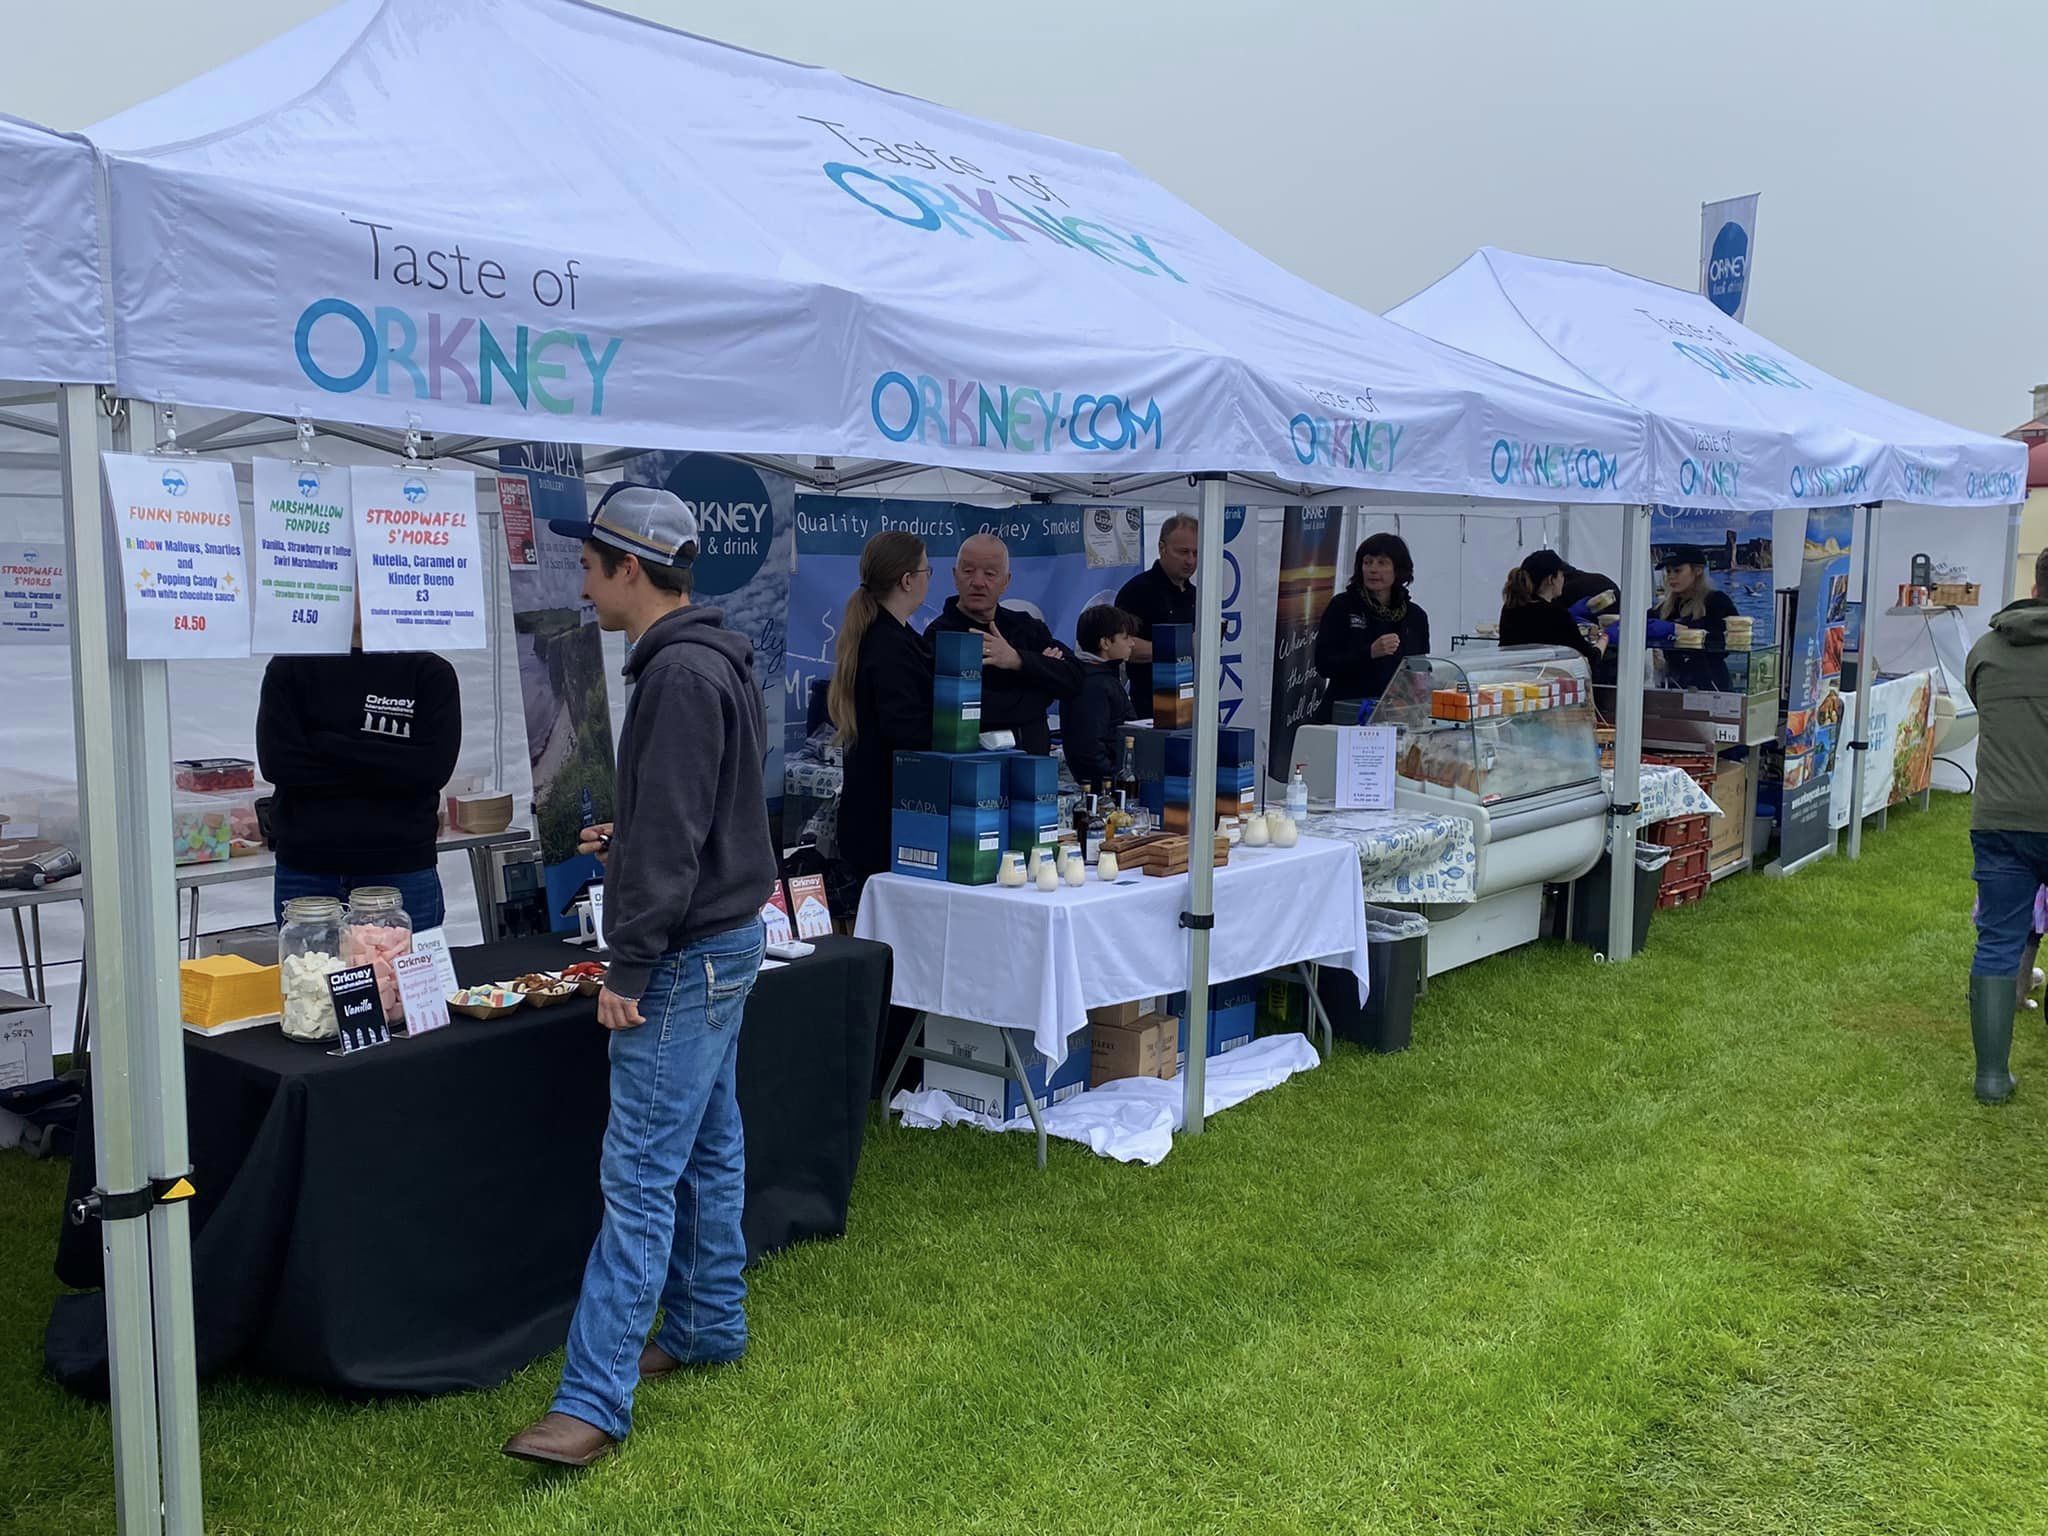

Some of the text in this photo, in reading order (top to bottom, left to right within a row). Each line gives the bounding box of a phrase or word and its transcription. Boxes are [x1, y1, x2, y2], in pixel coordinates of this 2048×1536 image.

[798, 116, 1070, 208] Taste of
[823, 162, 1189, 284] ORKNEY
[339, 212, 581, 310] Taste of
[294, 298, 625, 416] ORKNEY
[1672, 341, 1813, 390] ORKNEY
[1355, 387, 1380, 413] of
[871, 371, 1162, 451] ORKNEY.COM
[1290, 413, 1404, 472] ORKNEY
[521, 444, 578, 479] SCAPA
[1680, 458, 1741, 497] ORKNEY
[500, 483, 526, 495] UNDER
[129, 506, 231, 527] FUNKY FONDUES
[270, 499, 344, 519] MARSHMALLOW
[687, 501, 768, 534] RKNEY
[285, 518, 330, 534] FONDUES
[366, 509, 467, 528] STROOPWAFEL
[796, 511, 869, 537] Quality
[881, 515, 954, 536] Products
[978, 521, 1031, 539] Orkney
[1043, 518, 1081, 537] Smoked
[126, 537, 241, 556] Rainbow Mallows, Smarties
[388, 529, 449, 546] S'MORES
[707, 537, 718, 555] &
[723, 536, 758, 555] drink
[262, 539, 352, 557] Vanilla, Strawberry or Toffee
[177, 558, 193, 569] and
[274, 555, 338, 570] Swirl Marshmallows
[372, 554, 467, 569] Nutella, Caramel or
[1, 565, 63, 577] STROOPWAFEL
[388, 572, 454, 586] Kinder Bueno
[15, 576, 51, 587] S'MORES
[157, 573, 217, 588] Popping Candy
[140, 589, 235, 602] with white chocolate sauce
[416, 589, 430, 602] £3
[174, 615, 206, 631] £4.50
[292, 609, 318, 624] £4.50
[366, 694, 415, 708] Orkney
[900, 798, 938, 816] SCAPA
[397, 954, 432, 969] Orkney
[331, 968, 371, 985] Orkney
[344, 998, 372, 1017] Vanilla
